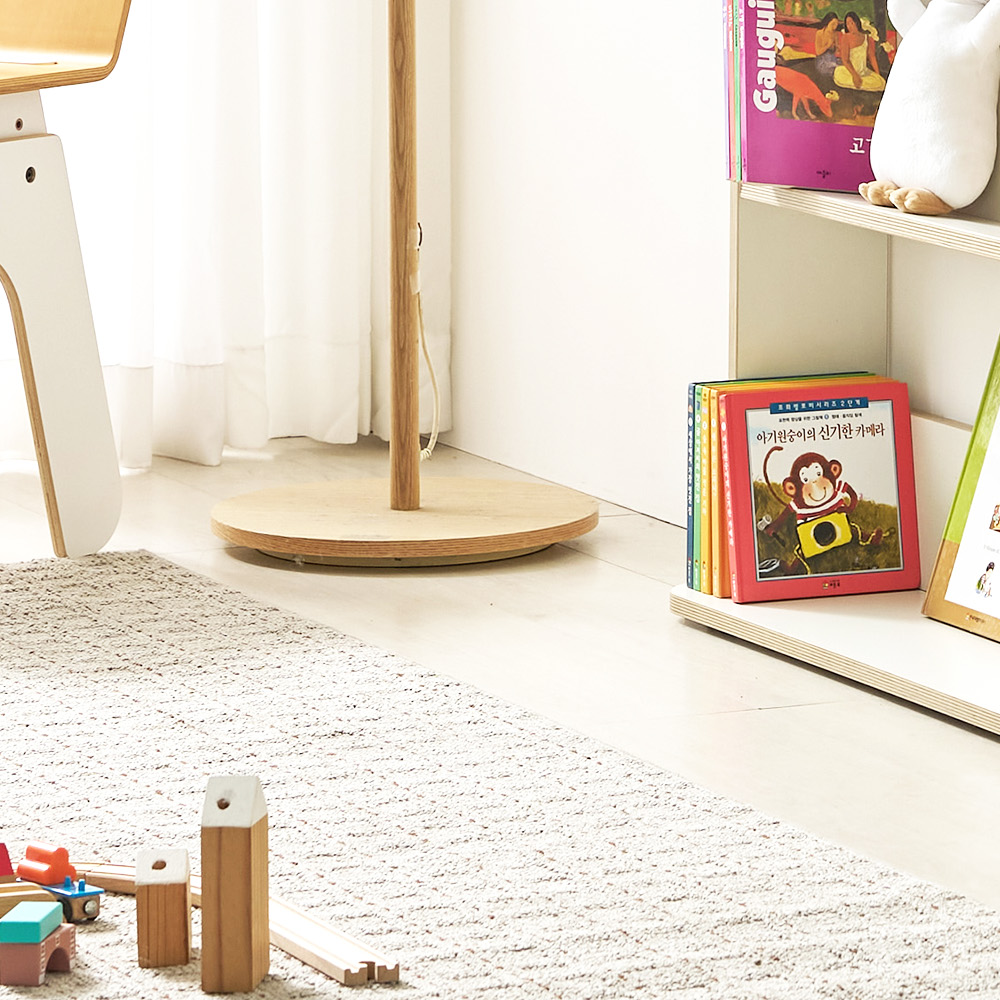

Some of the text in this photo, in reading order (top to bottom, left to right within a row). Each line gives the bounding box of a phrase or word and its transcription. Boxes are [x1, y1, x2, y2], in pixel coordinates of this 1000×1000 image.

[849, 137, 872, 154] 고
[756, 422, 886, 445] 아기원숭이의 신기한 카메라
